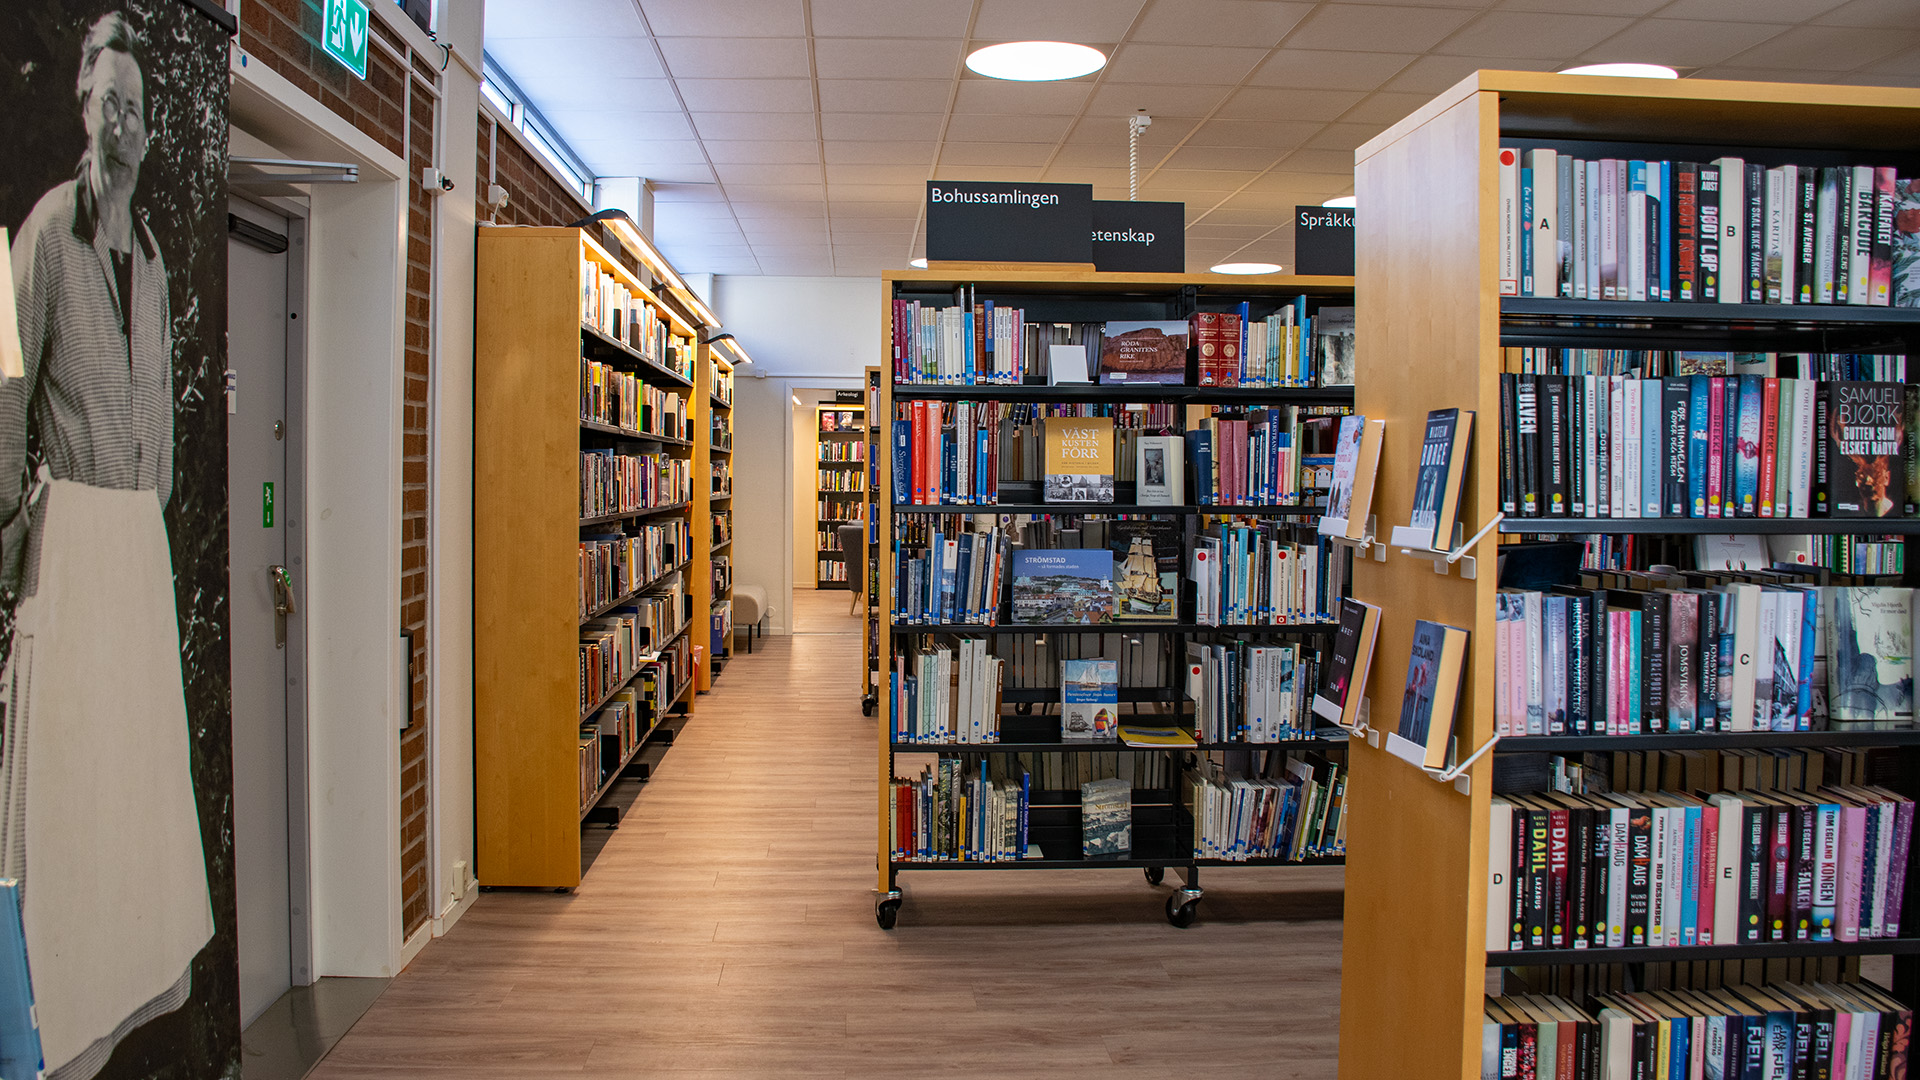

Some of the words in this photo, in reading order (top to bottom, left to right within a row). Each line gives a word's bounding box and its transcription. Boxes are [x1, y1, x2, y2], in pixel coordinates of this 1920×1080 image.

[1701, 171, 1718, 181] KURT
[1701, 182, 1718, 191] AUST
[932, 188, 1059, 209] Bohussamlingen
[1752, 197, 1762, 205] VI
[1540, 218, 1550, 230] A
[1700, 206, 1718, 241] DØDT
[1752, 207, 1762, 228] SKAL
[1803, 213, 1813, 225] ST.
[1857, 191, 1873, 256] BARCODE
[1877, 194, 1893, 246] KALIFATET
[1727, 226, 1736, 238] B
[1752, 230, 1762, 249] IKKE
[1803, 227, 1813, 264] AVENGER
[1840, 235, 1849, 269] ENGELENS
[1700, 245, 1718, 272] LØP
[1752, 252, 1762, 277] VÅKNE
[1614, 400, 1621, 410] En
[1839, 386, 1900, 404] SAMUEL
[1519, 394, 1536, 434] ULVEN
[1677, 401, 1686, 421] FØR
[1741, 394, 1750, 433] BREKKE
[1751, 392, 1759, 435] JØRGEN
[1818, 401, 1826, 424] GUTTEN
[1840, 404, 1900, 425] BJØRK
[1766, 414, 1775, 454] BREKKE
[1818, 425, 1826, 439] SOM
[1843, 426, 1875, 440] GUTTEN
[1876, 426, 1895, 440] SOM
[1062, 447, 1099, 459] FÖRR
[1599, 433, 1607, 472] DORTHEA
[1677, 425, 1686, 483] HIMMELEN
[1818, 441, 1826, 462] ELSKET
[1840, 441, 1870, 455] ELSKET
[1871, 441, 1899, 455] RÅDYR
[897, 450, 907, 480] Sveriges
[1551, 465, 1559, 484] SKOGEN
[1599, 474, 1607, 501] BJØRK
[1025, 556, 1066, 564] STRÖMSTAD
[1572, 602, 1582, 649] BRENDEN
[1335, 654, 1347, 665] UTEN
[1709, 643, 1718, 701] JOMSVIKING
[1740, 654, 1750, 665] C
[1581, 655, 1589, 692] SKYGGER
[1679, 645, 1689, 709] JOMSVIKING
[1752, 813, 1761, 823] TOM
[1777, 812, 1788, 823] TOM
[1802, 811, 1812, 827] TOM
[1824, 810, 1835, 827] TOM
[1614, 823, 1626, 866] DAMHAUG
[1752, 824, 1761, 845] EGELAND
[1777, 824, 1788, 844] EGELAND
[1802, 828, 1812, 860] EGELAND
[1824, 828, 1835, 859] EGELAND
[1532, 828, 1547, 874] DAHL
[1551, 828, 1566, 873] DAHL
[1633, 835, 1648, 886] DAMHAUG
[1493, 873, 1503, 885] D
[1723, 867, 1732, 879] E
[1820, 862, 1836, 901] KONGEN
[1534, 877, 1542, 909] LAZARUS
[1554, 877, 1562, 923] ASSISTENTEN
[1796, 871, 1812, 909] FALKEN
[1654, 882, 1663, 926] DESEMBER
[1745, 1026, 1762, 1072] FJELL
[1772, 1025, 1780, 1051] ERIK
[1795, 1023, 1809, 1064] FJELL
[1815, 1021, 1829, 1062] FJELL
[1880, 1032, 1890, 1050] Helga
[1502, 1047, 1512, 1077] ENGER
[1880, 1051, 1890, 1075] Flatland
